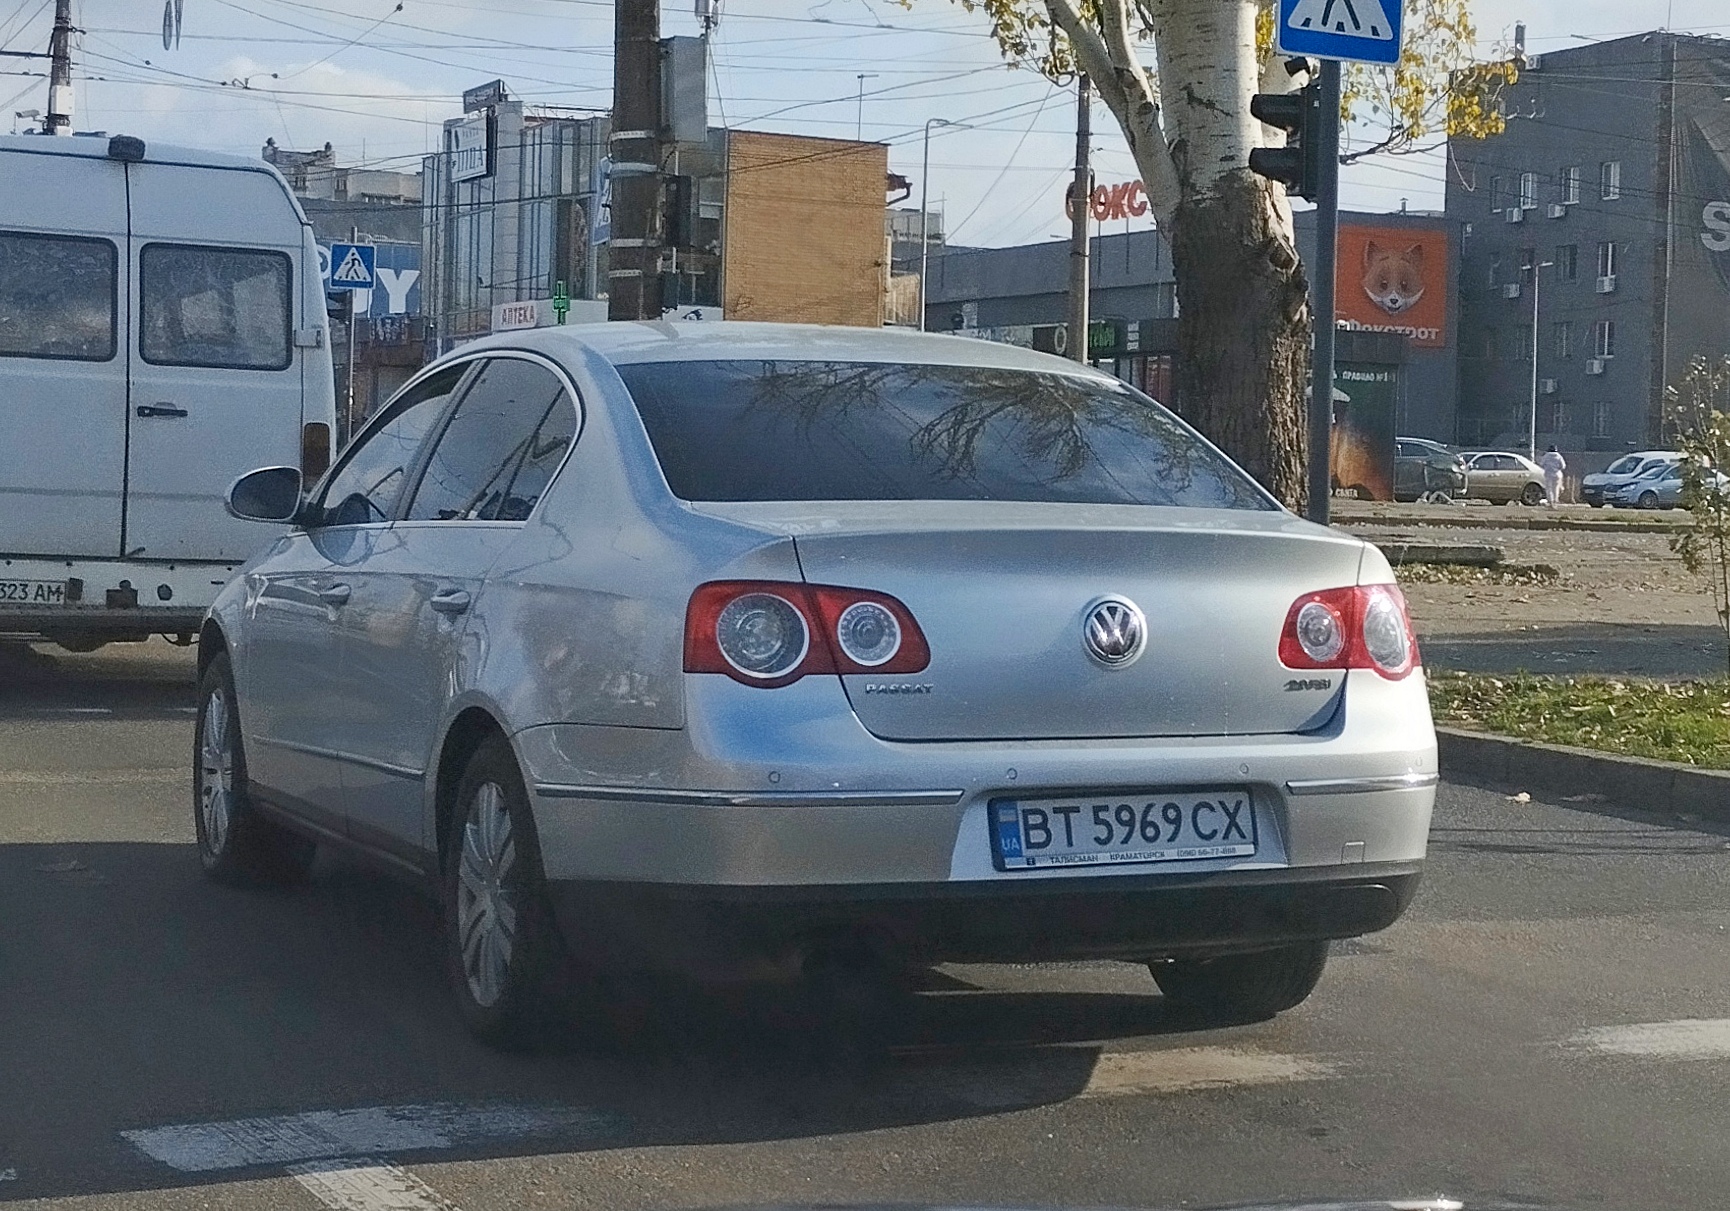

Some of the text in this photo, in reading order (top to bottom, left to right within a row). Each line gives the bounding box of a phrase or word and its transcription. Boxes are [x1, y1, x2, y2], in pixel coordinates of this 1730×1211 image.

[501, 305, 535, 325] АПТЕКА
[0, 583, 62, 602] 323 AM
[865, 683, 935, 695] PASSAT
[1022, 800, 1247, 849] BT 5969 CX
[1001, 837, 1020, 850] UA
[1049, 855, 1099, 865] ТАЛИСМАН
[1109, 850, 1166, 862] КРАМАТОРСК
